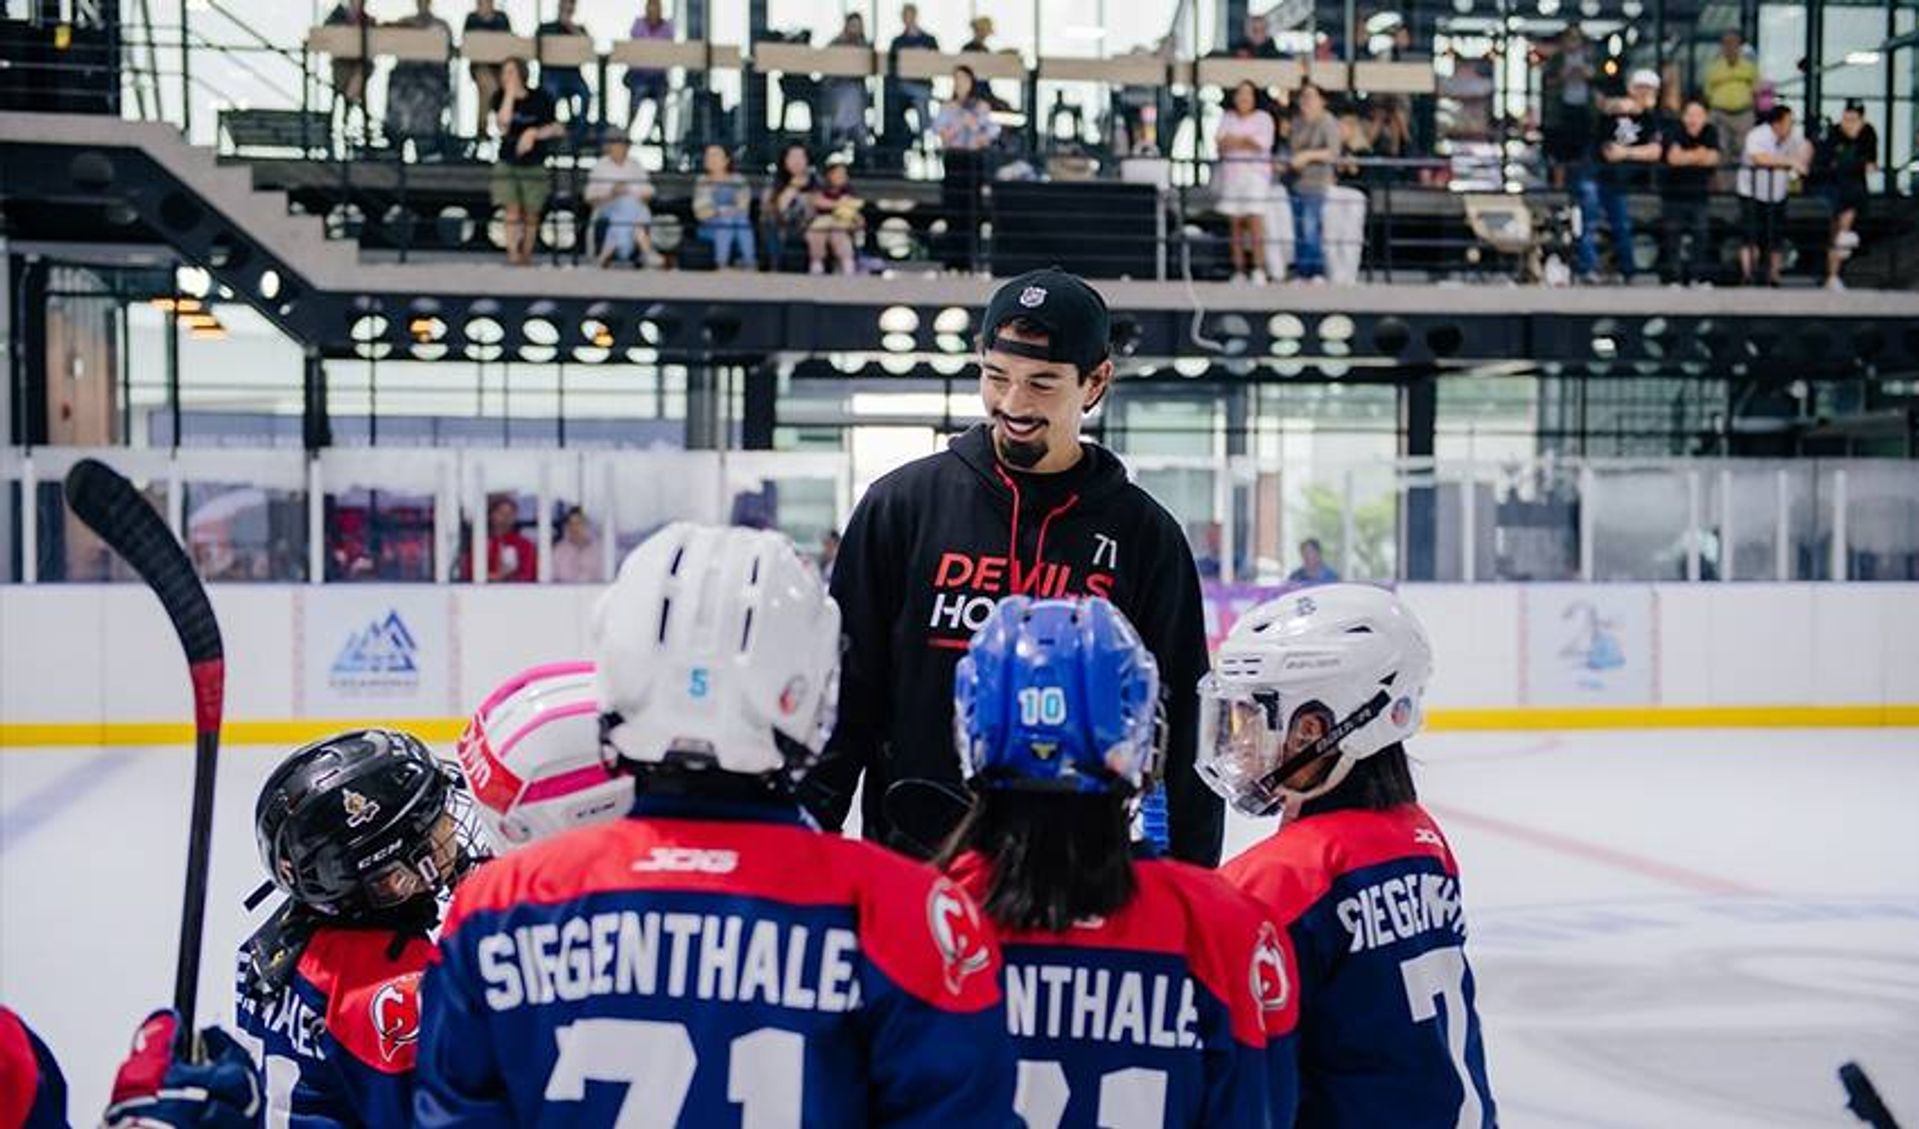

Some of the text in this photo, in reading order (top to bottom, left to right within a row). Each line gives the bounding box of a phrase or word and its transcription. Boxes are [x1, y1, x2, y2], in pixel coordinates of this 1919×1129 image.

[1093, 533, 1117, 569] 71
[935, 553, 1115, 601] DEVILS
[930, 594, 996, 631] HO
[689, 667, 709, 697] 5
[1018, 686, 1067, 726] 10
[357, 837, 403, 870] CCM
[478, 910, 863, 1013] SIEGENTHALE
[1005, 964, 1203, 1050] NTHALE
